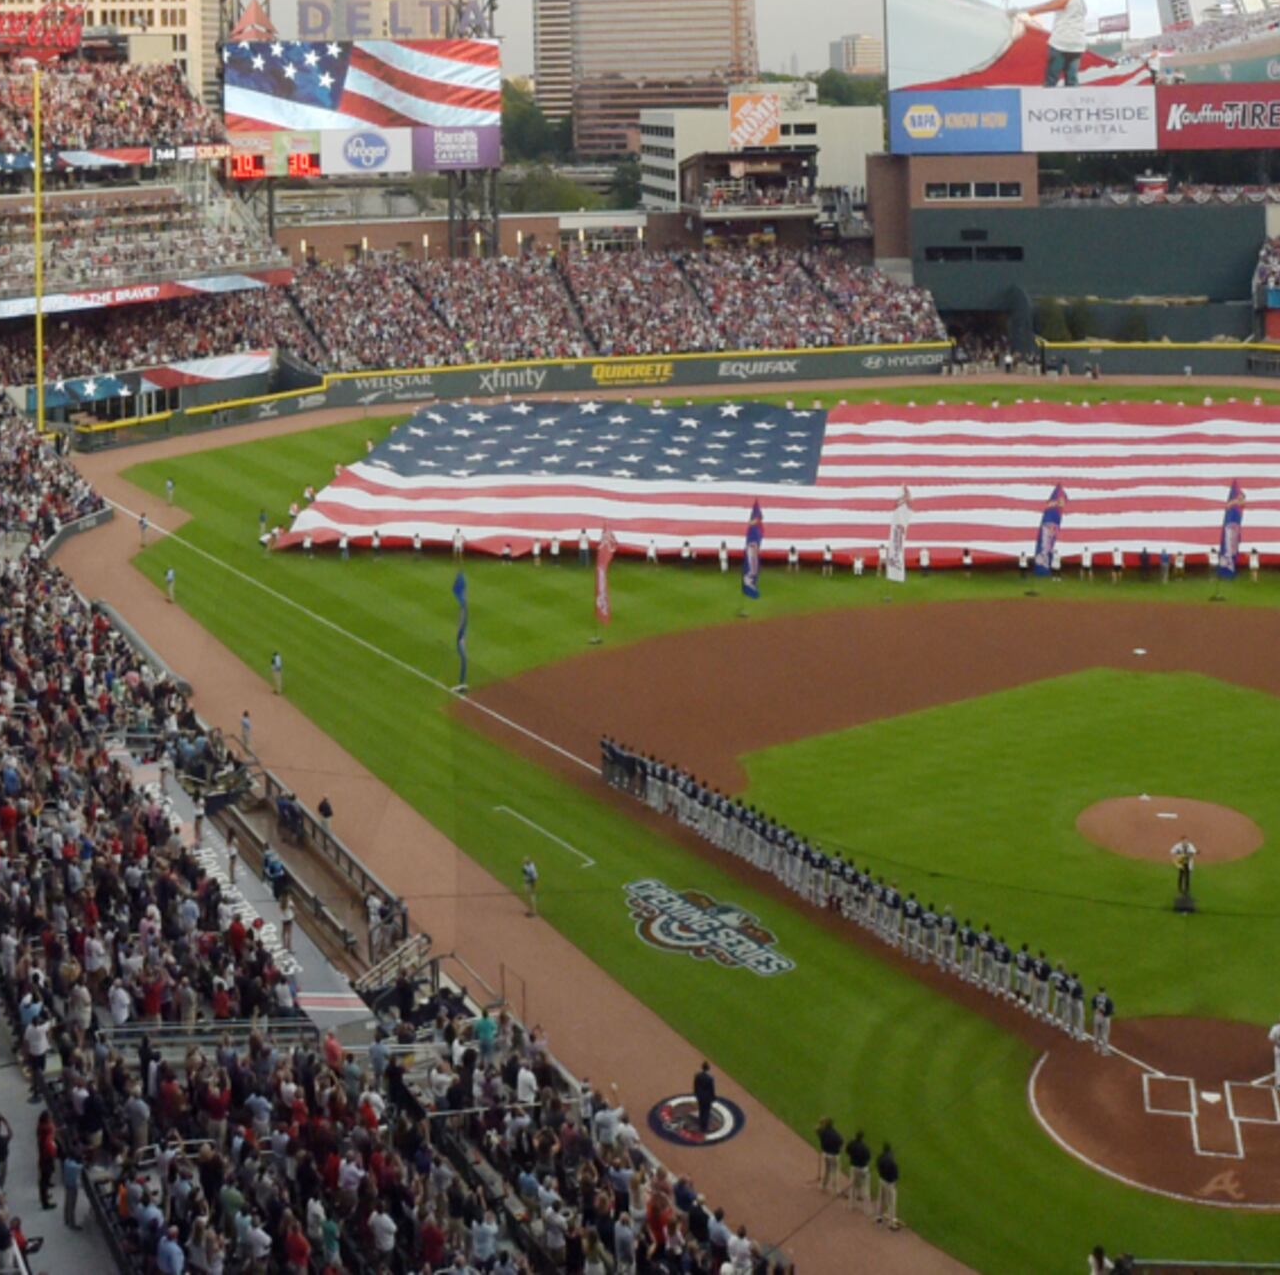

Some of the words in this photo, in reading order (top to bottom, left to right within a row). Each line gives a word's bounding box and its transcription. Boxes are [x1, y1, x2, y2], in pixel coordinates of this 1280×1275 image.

[298, 0, 487, 37] DELTA
[909, 113, 937, 130] NAPA
[945, 113, 978, 129] KNOW
[980, 112, 1008, 128] HOW
[1028, 106, 1149, 122] NORTHSIDE
[1050, 124, 1127, 135] HOSPITAL
[348, 137, 387, 166] Kroger
[591, 363, 674, 380] QUIKRETE
[718, 358, 800, 379] EQUIFAX
[478, 367, 547, 393] xfinity
[623, 879, 721, 933] OPENING
[707, 927, 796, 975] SERIES
